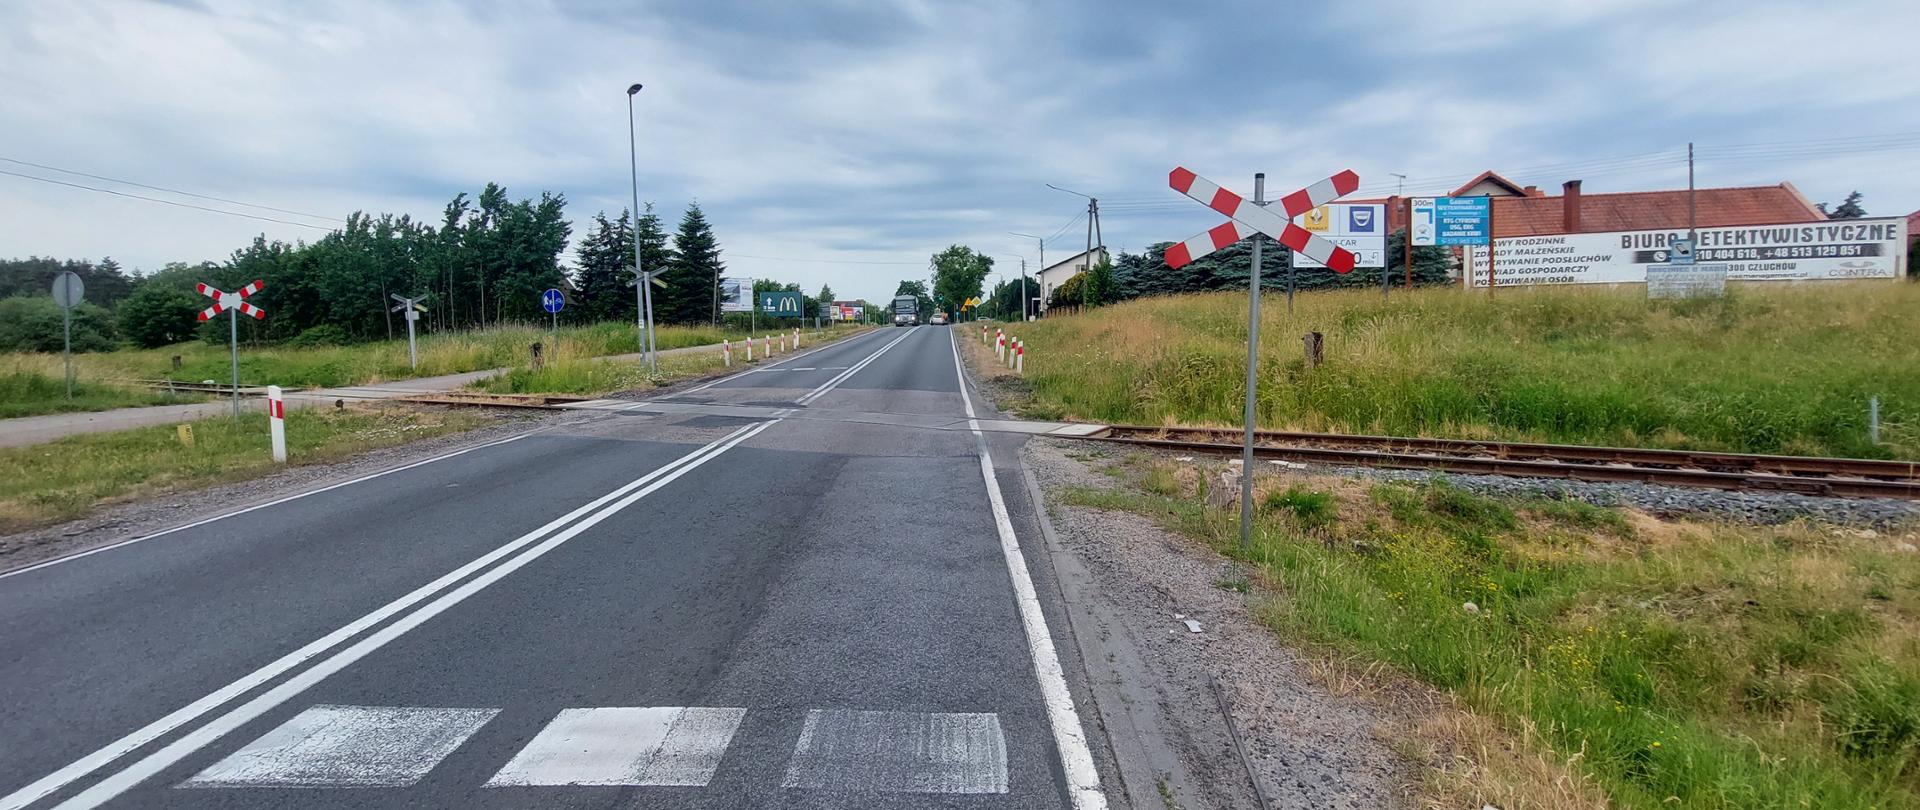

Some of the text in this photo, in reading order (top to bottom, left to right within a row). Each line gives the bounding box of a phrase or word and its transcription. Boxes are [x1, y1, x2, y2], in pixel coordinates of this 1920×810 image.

[1515, 237, 1566, 246] RODZINNE
[1474, 249, 1513, 258] ZDADY
[1714, 249, 1734, 259] 404
[1737, 248, 1760, 260] 618,
[1764, 247, 1788, 258] +48
[1791, 246, 1812, 257] 513
[1815, 246, 1836, 256] 129
[1840, 245, 1861, 256] 851
[1475, 254, 1612, 267] WYRYWANIE PODSŁUCHÓW
[1518, 265, 1590, 275] GOSPODARCZY
[1728, 263, 1745, 272] 300
[1829, 268, 1888, 277] CONTRA
